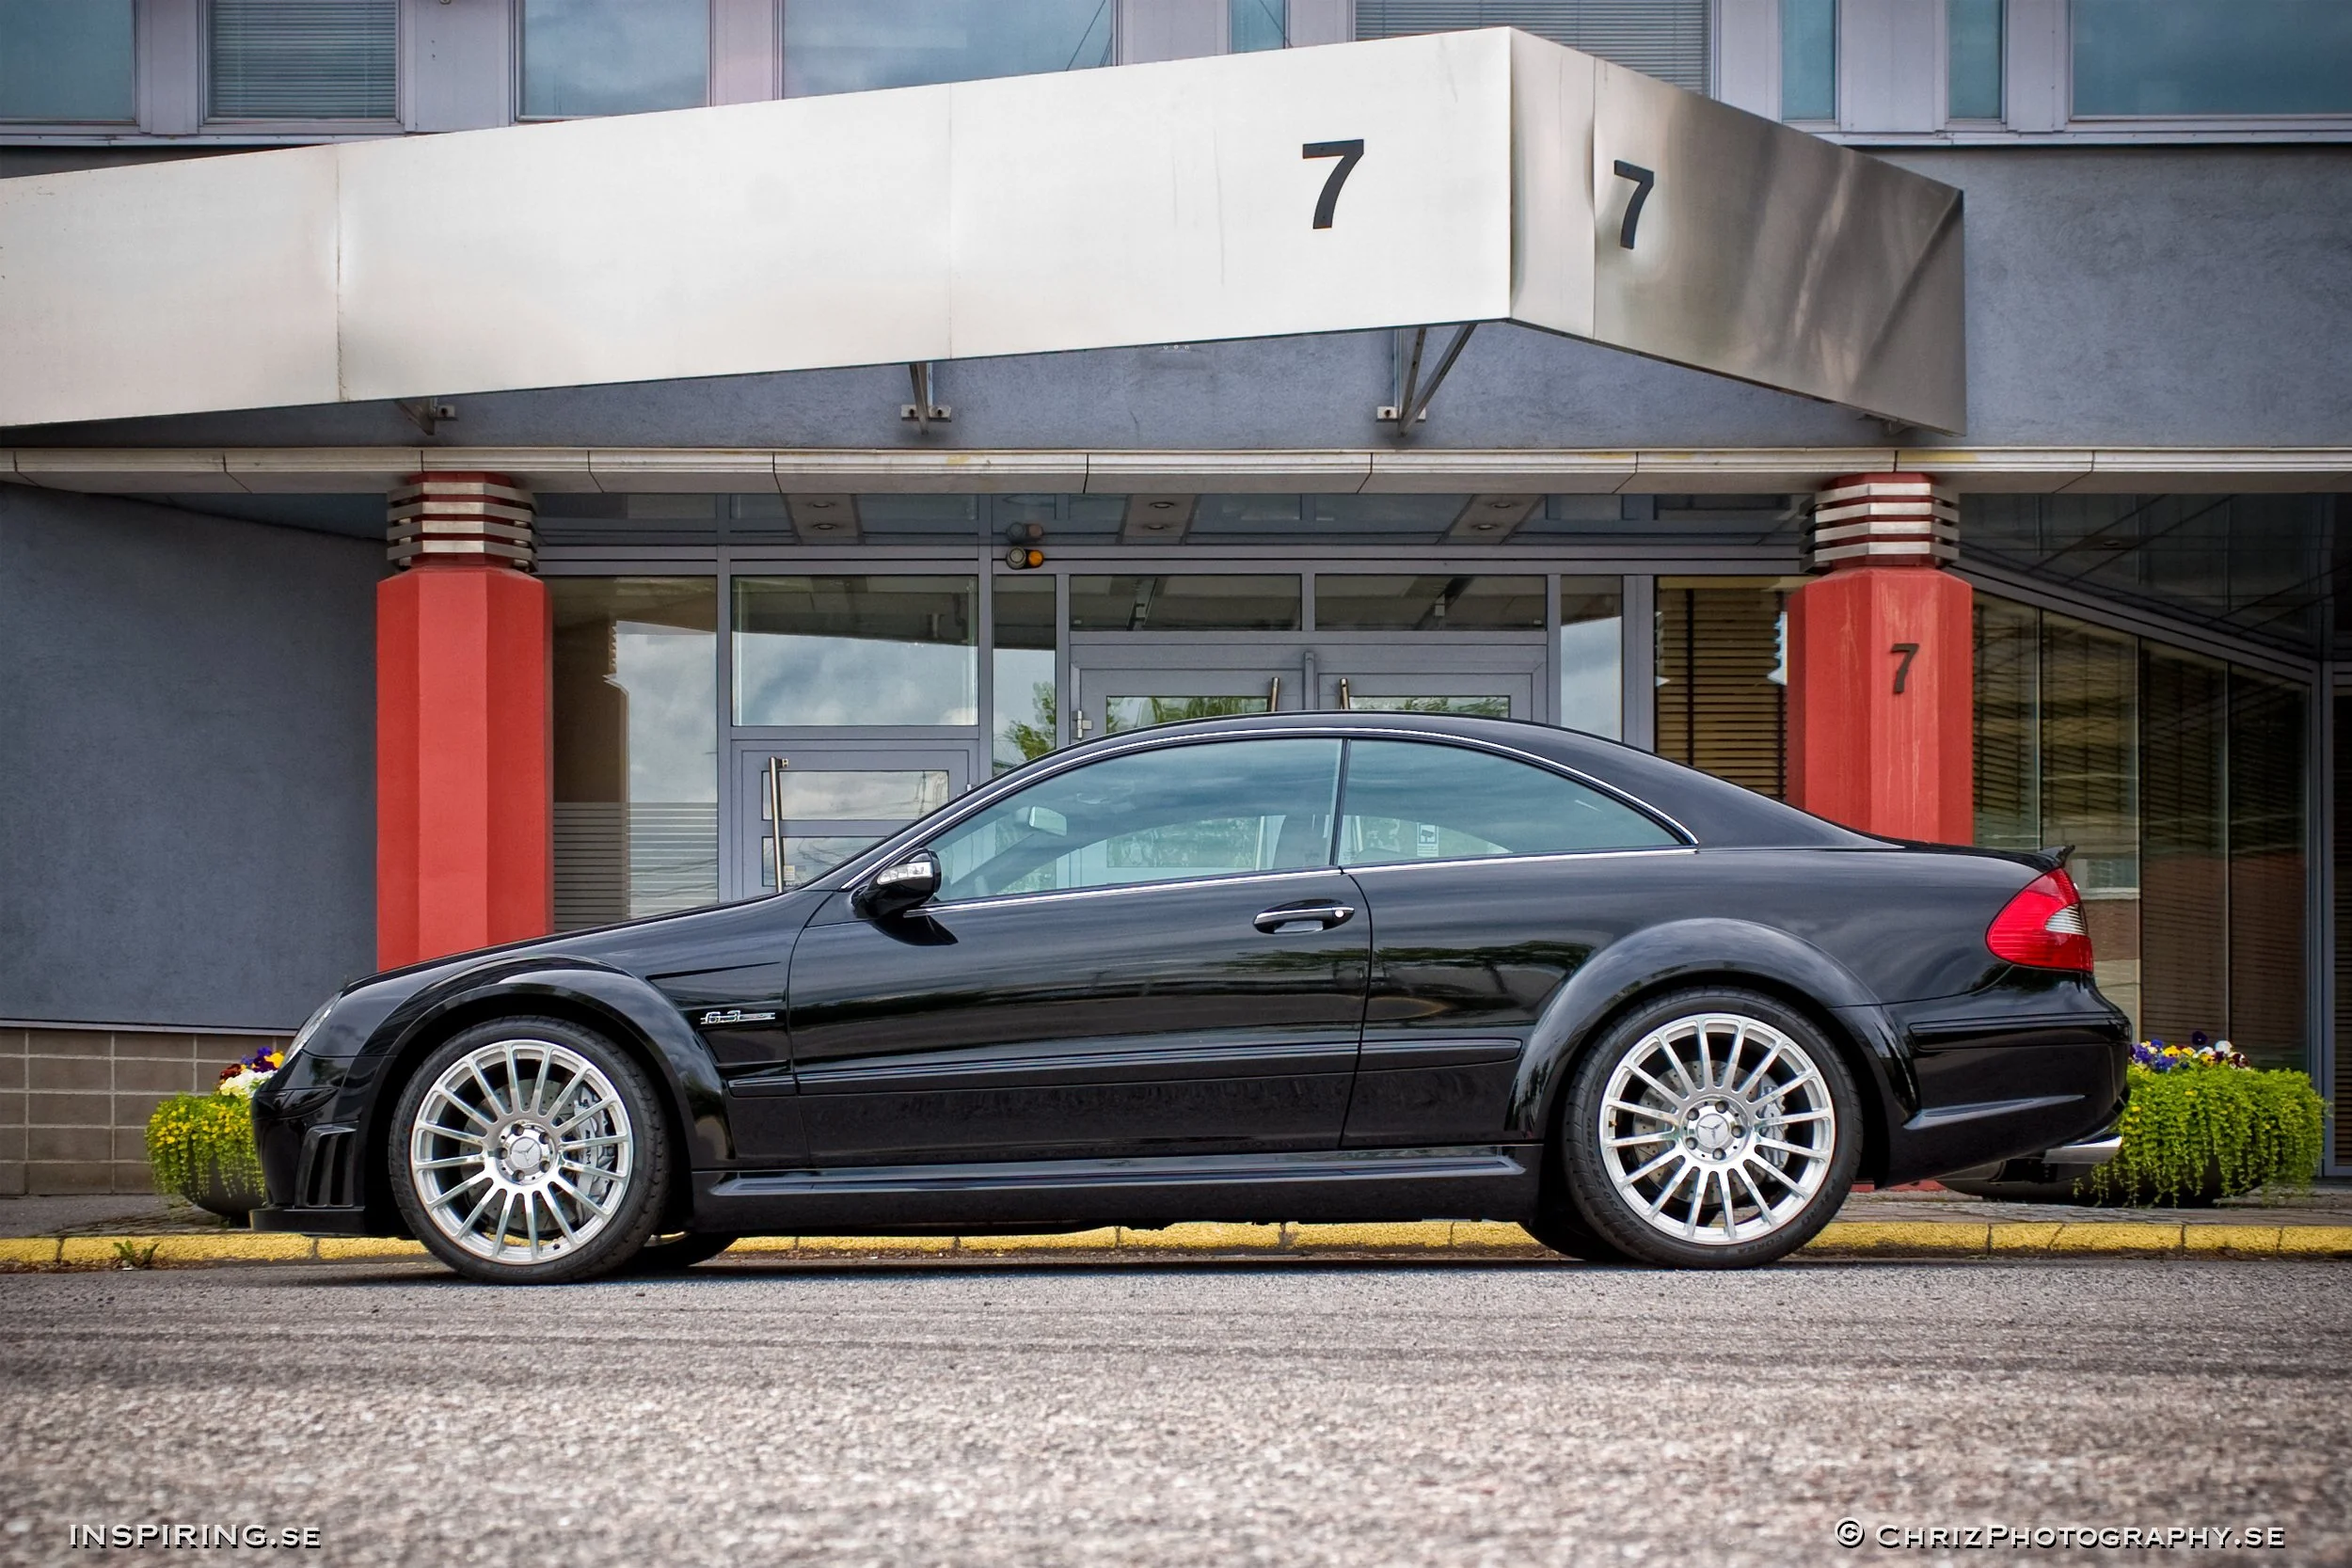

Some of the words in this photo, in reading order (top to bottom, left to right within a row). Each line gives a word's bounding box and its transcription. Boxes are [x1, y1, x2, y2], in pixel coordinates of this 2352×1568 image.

[1302, 138, 1364, 230] 7
[1613, 159, 1655, 250] 7
[1890, 642, 1920, 695] 7
